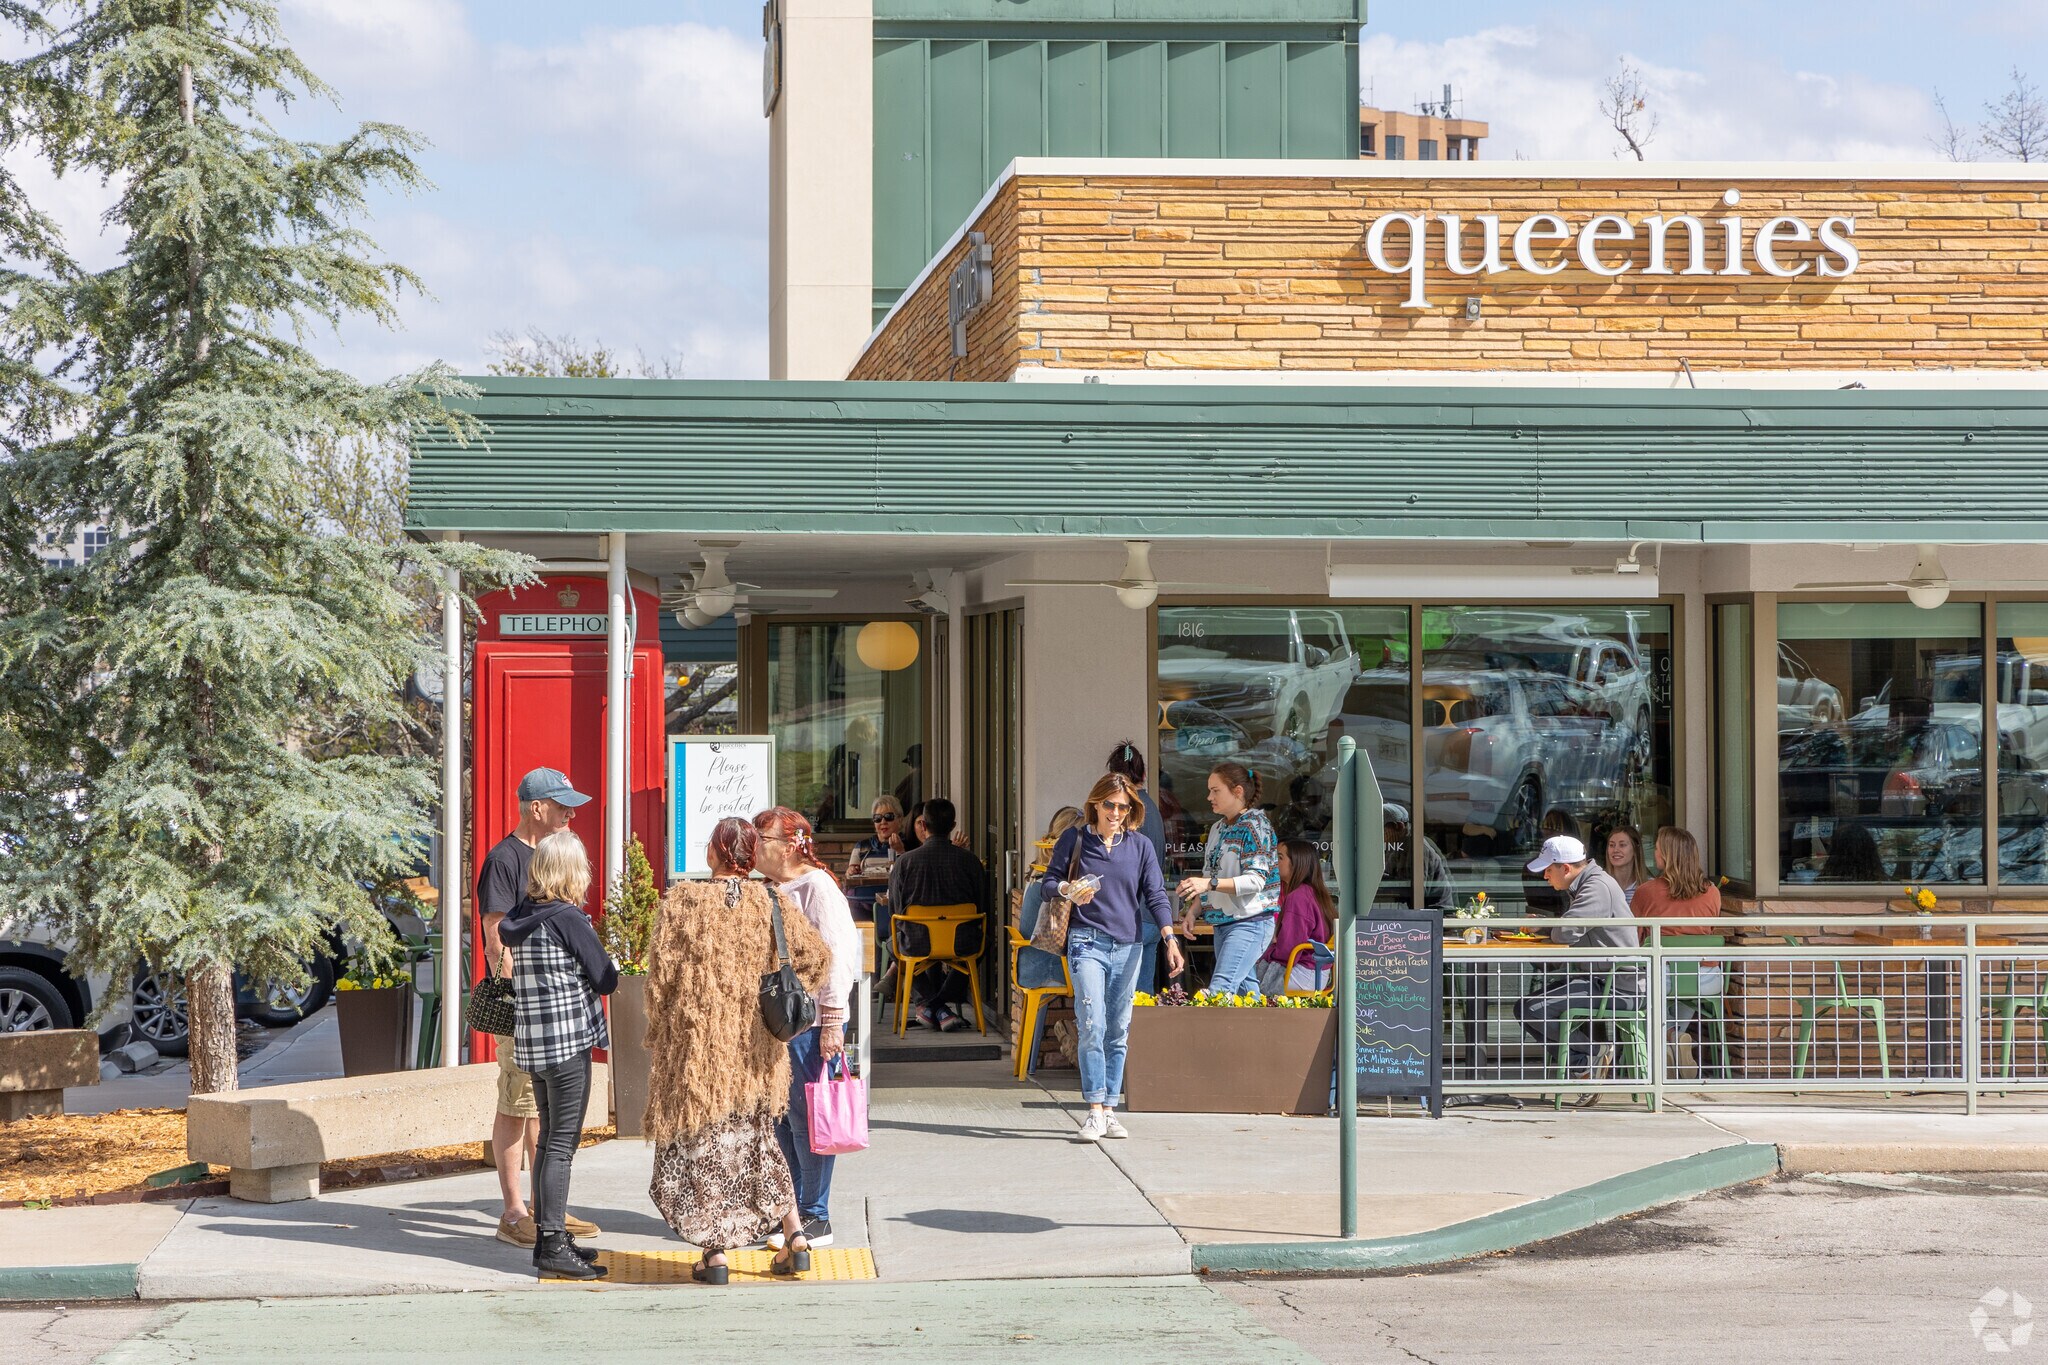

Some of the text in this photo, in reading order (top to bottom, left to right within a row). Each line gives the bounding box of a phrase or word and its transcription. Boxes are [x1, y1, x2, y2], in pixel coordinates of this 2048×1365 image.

[1365, 188, 1860, 308] queenies
[507, 617, 629, 631] TELEPHO
[1179, 622, 1205, 637] 1816
[1188, 733, 1218, 748] Open
[708, 756, 748, 777] Please
[705, 774, 754, 794] wait to
[700, 794, 754, 814] be seated
[1370, 922, 1402, 932] Lunch
[1382, 933, 1406, 945] Bear
[1379, 956, 1407, 967] Chicken
[1407, 955, 1429, 966] Pasta
[1385, 966, 1408, 975] Salad
[1356, 990, 1381, 1000] hicken
